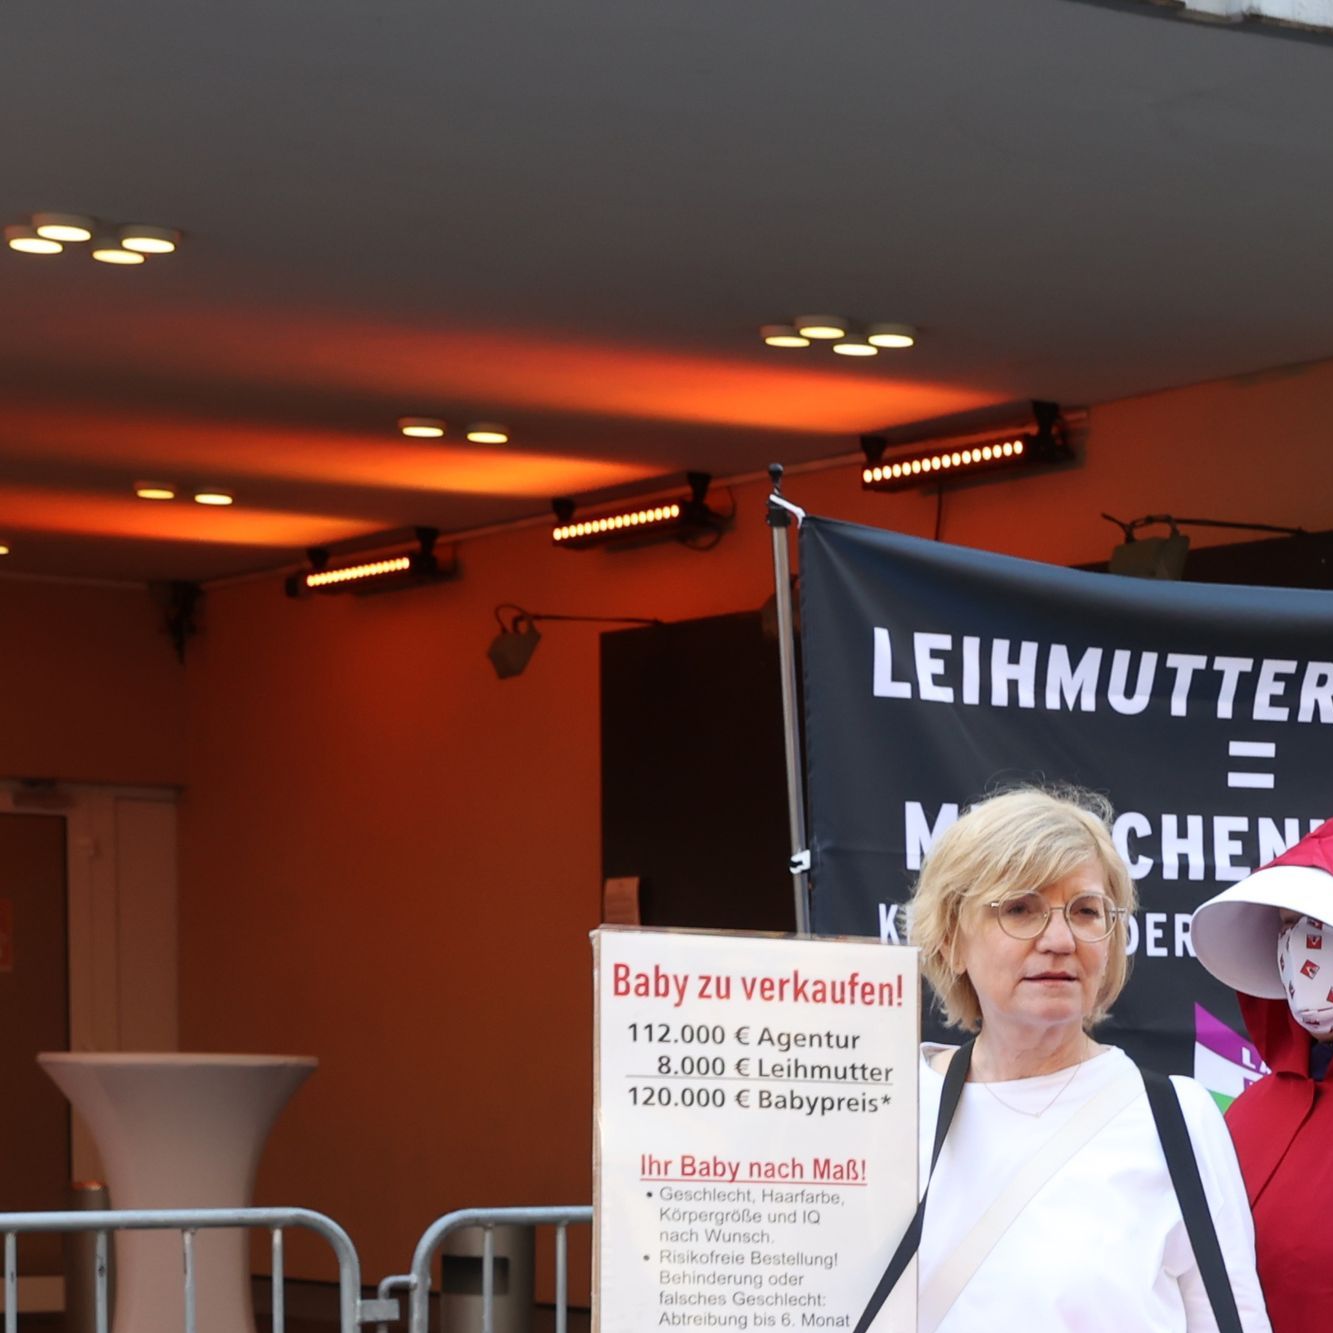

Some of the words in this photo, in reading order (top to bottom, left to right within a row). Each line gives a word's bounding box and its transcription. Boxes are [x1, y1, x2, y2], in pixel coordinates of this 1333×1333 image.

[613, 963, 690, 1008] Baby
[697, 974, 732, 1000] zu
[741, 969, 903, 1007] verkaufen!
[628, 1022, 725, 1045] 112.000
[734, 1026, 750, 1045] €
[757, 1027, 861, 1052] Agentur
[657, 1055, 725, 1076] 8.000
[734, 1057, 750, 1077] €
[758, 1058, 894, 1082] Leihmutter
[628, 1086, 726, 1108] 120.000
[734, 1089, 750, 1109] €
[640, 1154, 673, 1177] Ihr
[680, 1155, 740, 1183] Baby
[749, 1157, 804, 1180] nach
[812, 1158, 867, 1182] Maß!
[659, 1186, 756, 1204] Geschlecht,
[761, 1188, 845, 1207] Haarfarbe,
[659, 1207, 762, 1226] Körpergröße
[767, 1209, 798, 1224] und
[802, 1211, 821, 1225] IQ
[659, 1229, 699, 1243] nach
[705, 1229, 775, 1245] Wunsch.
[659, 1250, 745, 1265] Risikofreie
[750, 1251, 838, 1269] Bestellung!
[659, 1270, 763, 1289] Behinderung
[768, 1272, 804, 1286] oder
[659, 1291, 727, 1306] falsches
[732, 1291, 826, 1307] Geschlecht:
[658, 1312, 748, 1330] Abtreibung
[753, 1313, 776, 1327] bis
[801, 1314, 850, 1328] Monat
